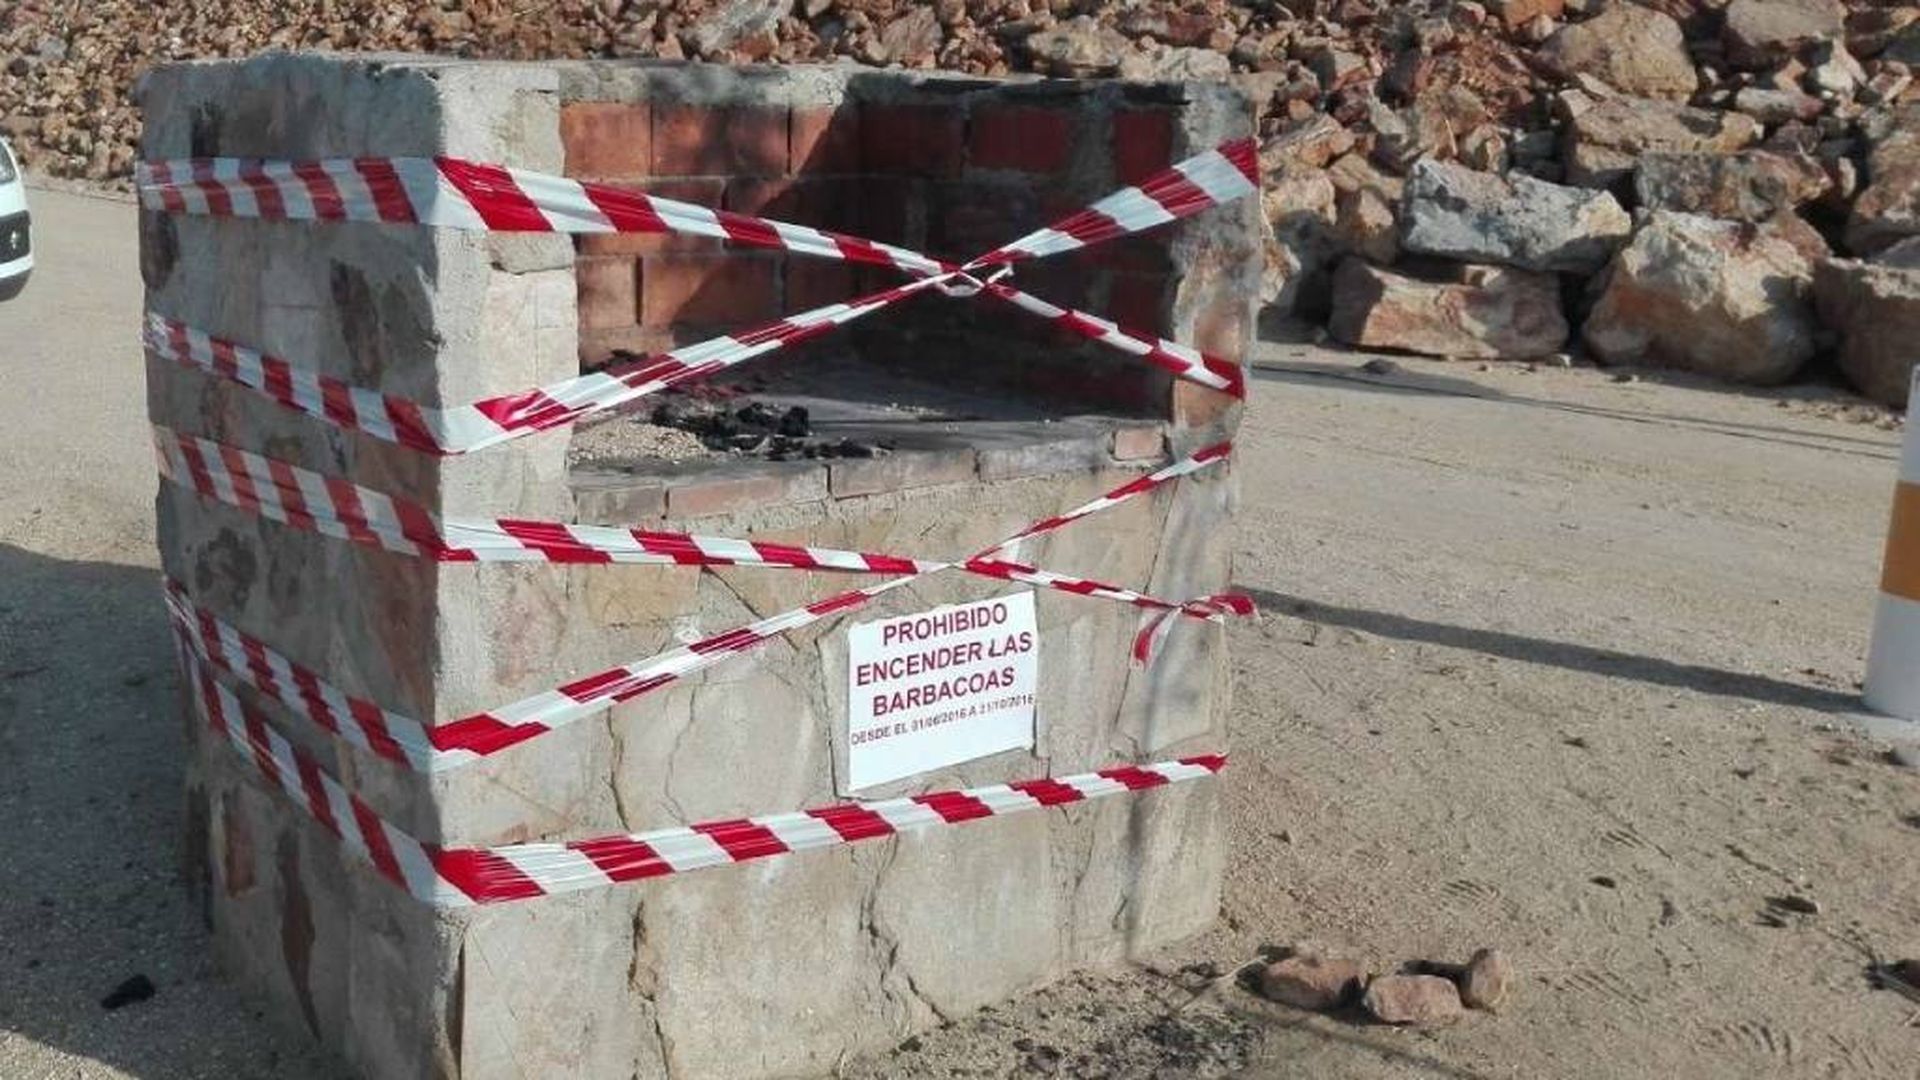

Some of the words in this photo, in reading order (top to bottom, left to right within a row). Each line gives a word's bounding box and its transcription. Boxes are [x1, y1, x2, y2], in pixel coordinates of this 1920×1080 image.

[883, 603, 1007, 645] PROHIBIDO
[857, 642, 982, 686] ENCENDER
[988, 632, 1032, 657] LAS
[873, 667, 1014, 716] BARBACOAS
[851, 724, 891, 745] DESDE
[894, 722, 908, 735] EL
[967, 706, 977, 717] A
